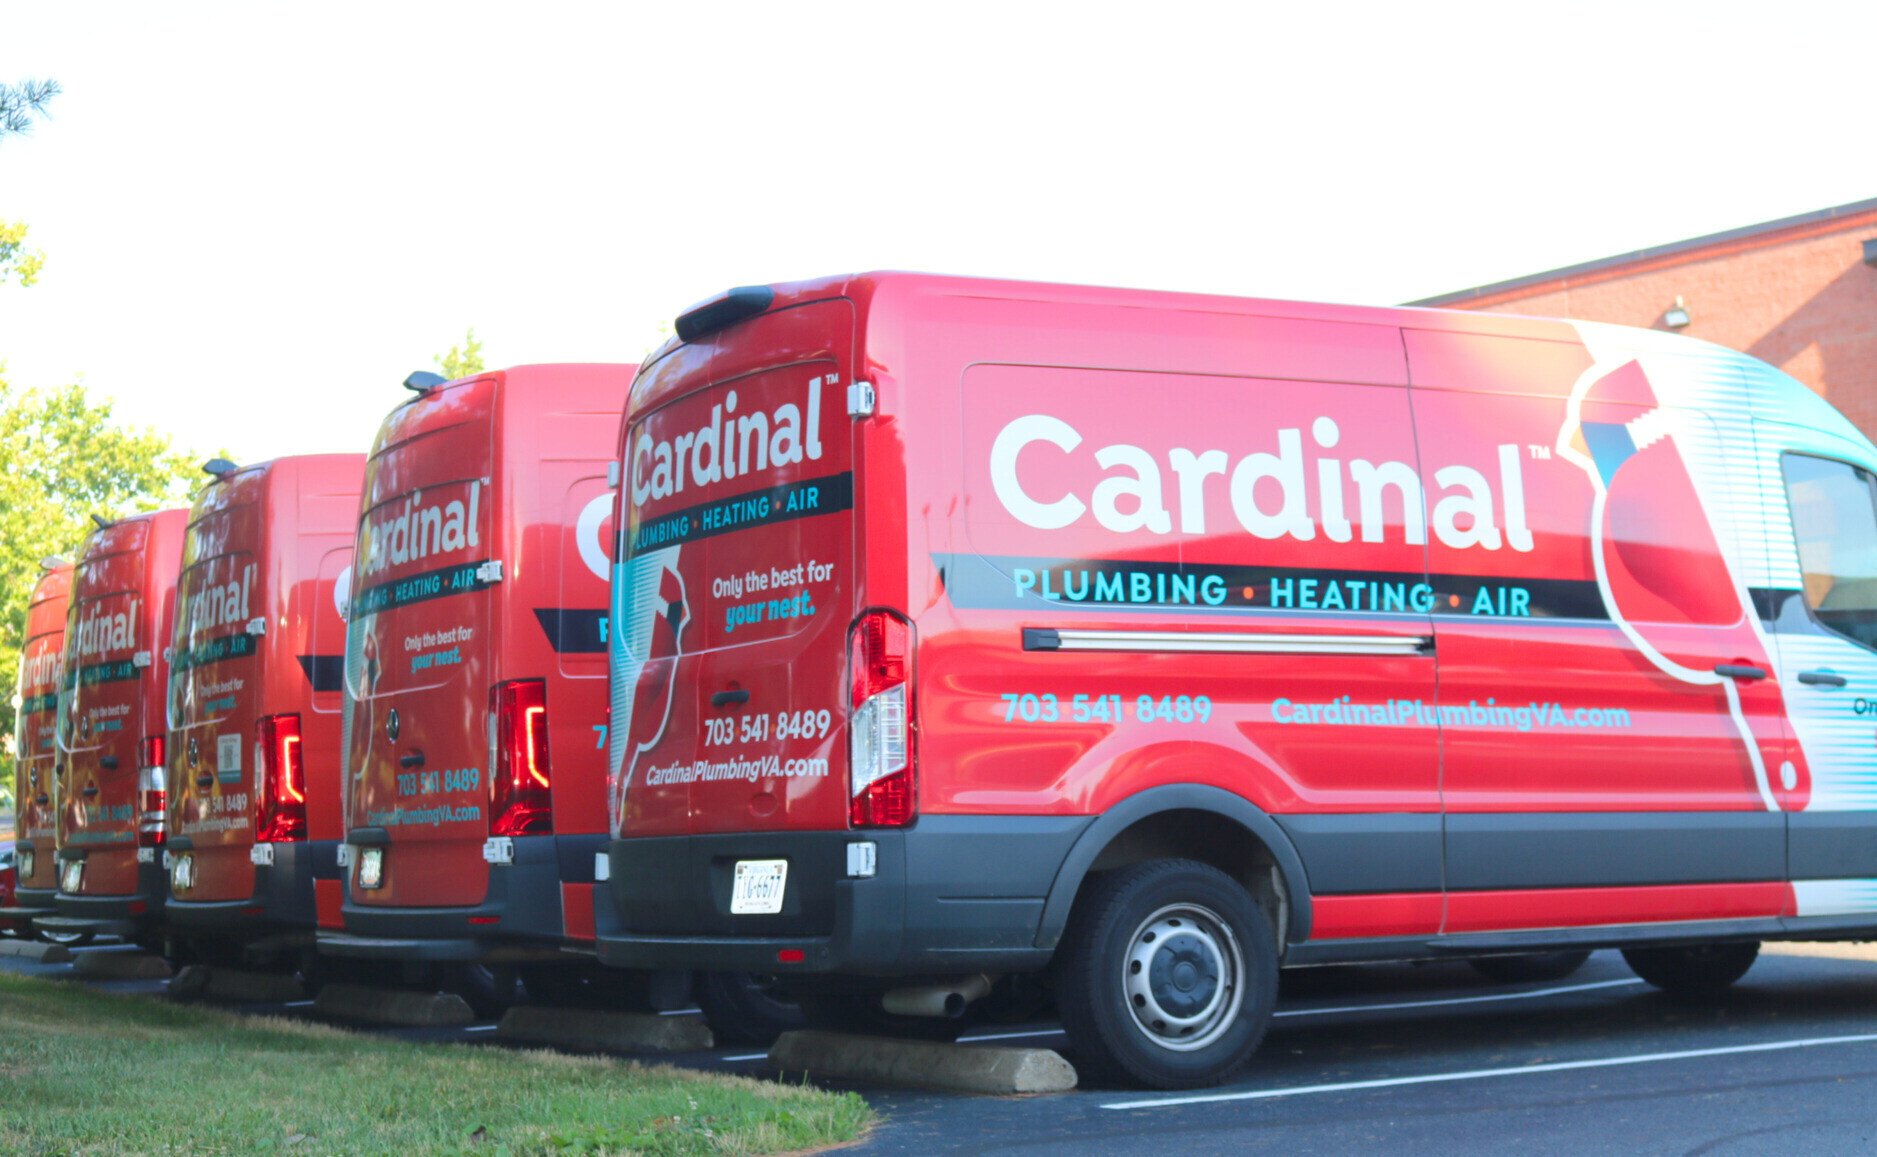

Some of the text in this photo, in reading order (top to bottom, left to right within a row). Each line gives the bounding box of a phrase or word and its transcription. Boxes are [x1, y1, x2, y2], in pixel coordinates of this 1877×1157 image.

[631, 376, 822, 507] Cardinal
[990, 414, 1534, 552] Cardinal
[703, 496, 770, 531] HEATING
[786, 487, 819, 513] AIR
[395, 575, 440, 602] HEATING
[452, 568, 475, 589] AIR
[712, 560, 834, 598] Only the best for
[1013, 568, 1531, 617] PLUMBING HEATING AIR
[725, 590, 816, 632] your nest.
[230, 637, 246, 653] AIR
[405, 626, 473, 651] Only the best for
[411, 653, 434, 674] your
[1001, 693, 1212, 723] 703 541 8489
[1271, 696, 1631, 731] CardinalPlumbingVA.com
[704, 709, 831, 746] 703 541 8489
[397, 768, 480, 796] 703 541 8489
[646, 754, 828, 786] CardinalPlumbingVA.com
[226, 793, 247, 811] 8489
